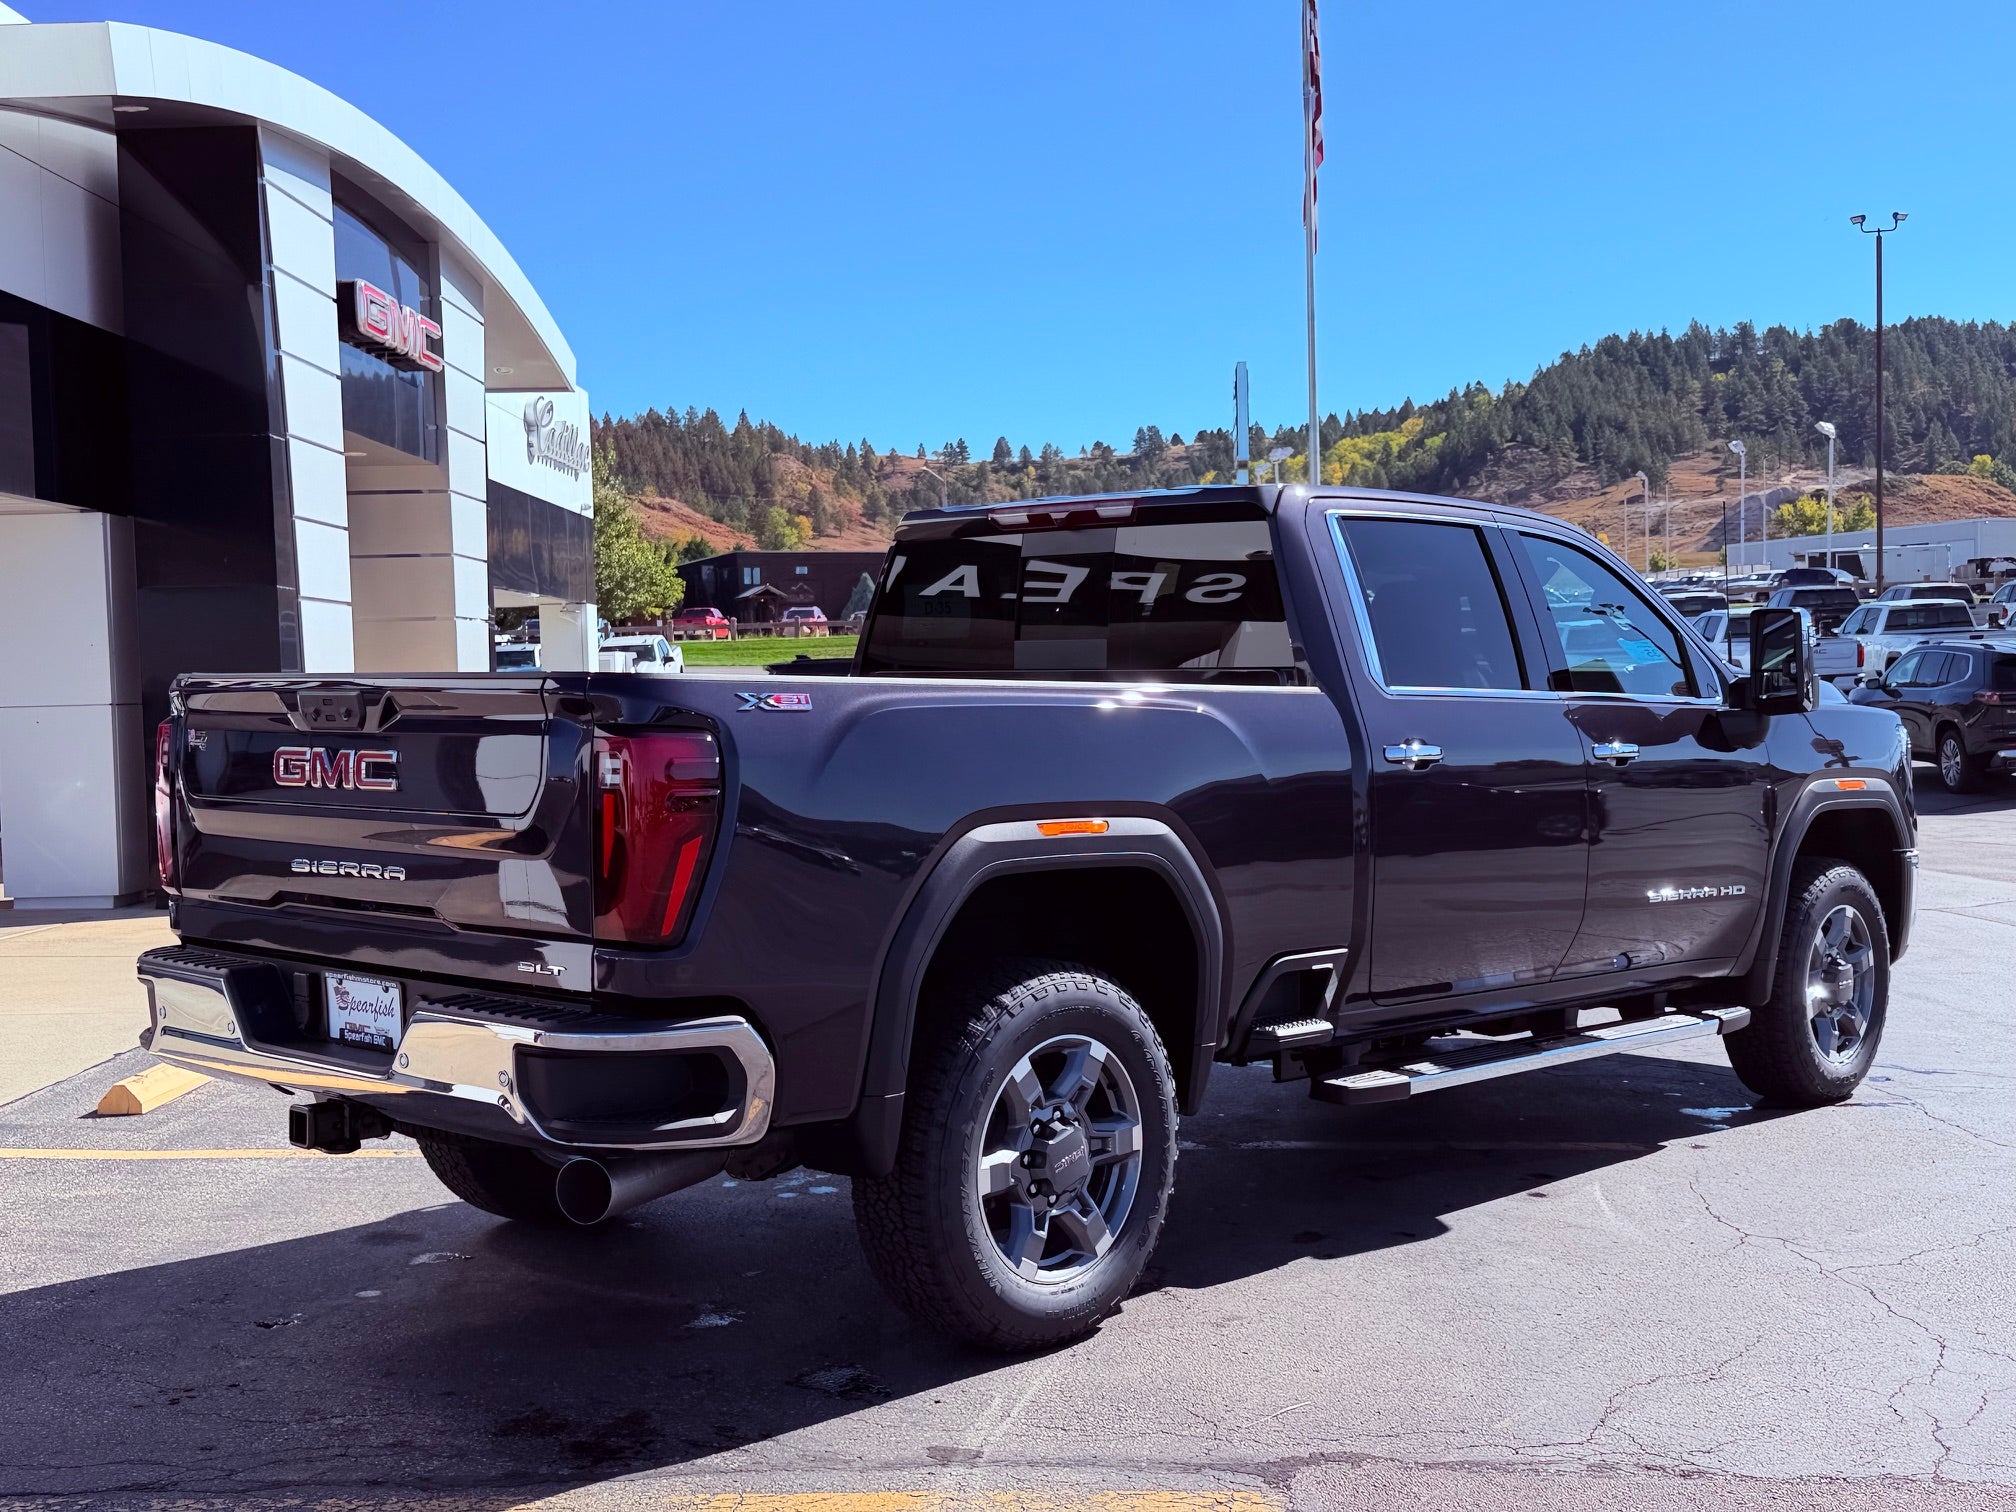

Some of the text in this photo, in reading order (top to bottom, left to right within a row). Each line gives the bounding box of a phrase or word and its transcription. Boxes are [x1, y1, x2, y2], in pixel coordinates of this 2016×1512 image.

[354, 278, 443, 373] GMC
[523, 395, 590, 482] Cadillac
[273, 746, 401, 791] GMC
[290, 858, 406, 881] SIERRA
[1647, 884, 1746, 903] SIERRA HD
[517, 961, 567, 976] SLT
[337, 989, 395, 1023] Spearfish
[344, 1030, 373, 1043] Spearfish
